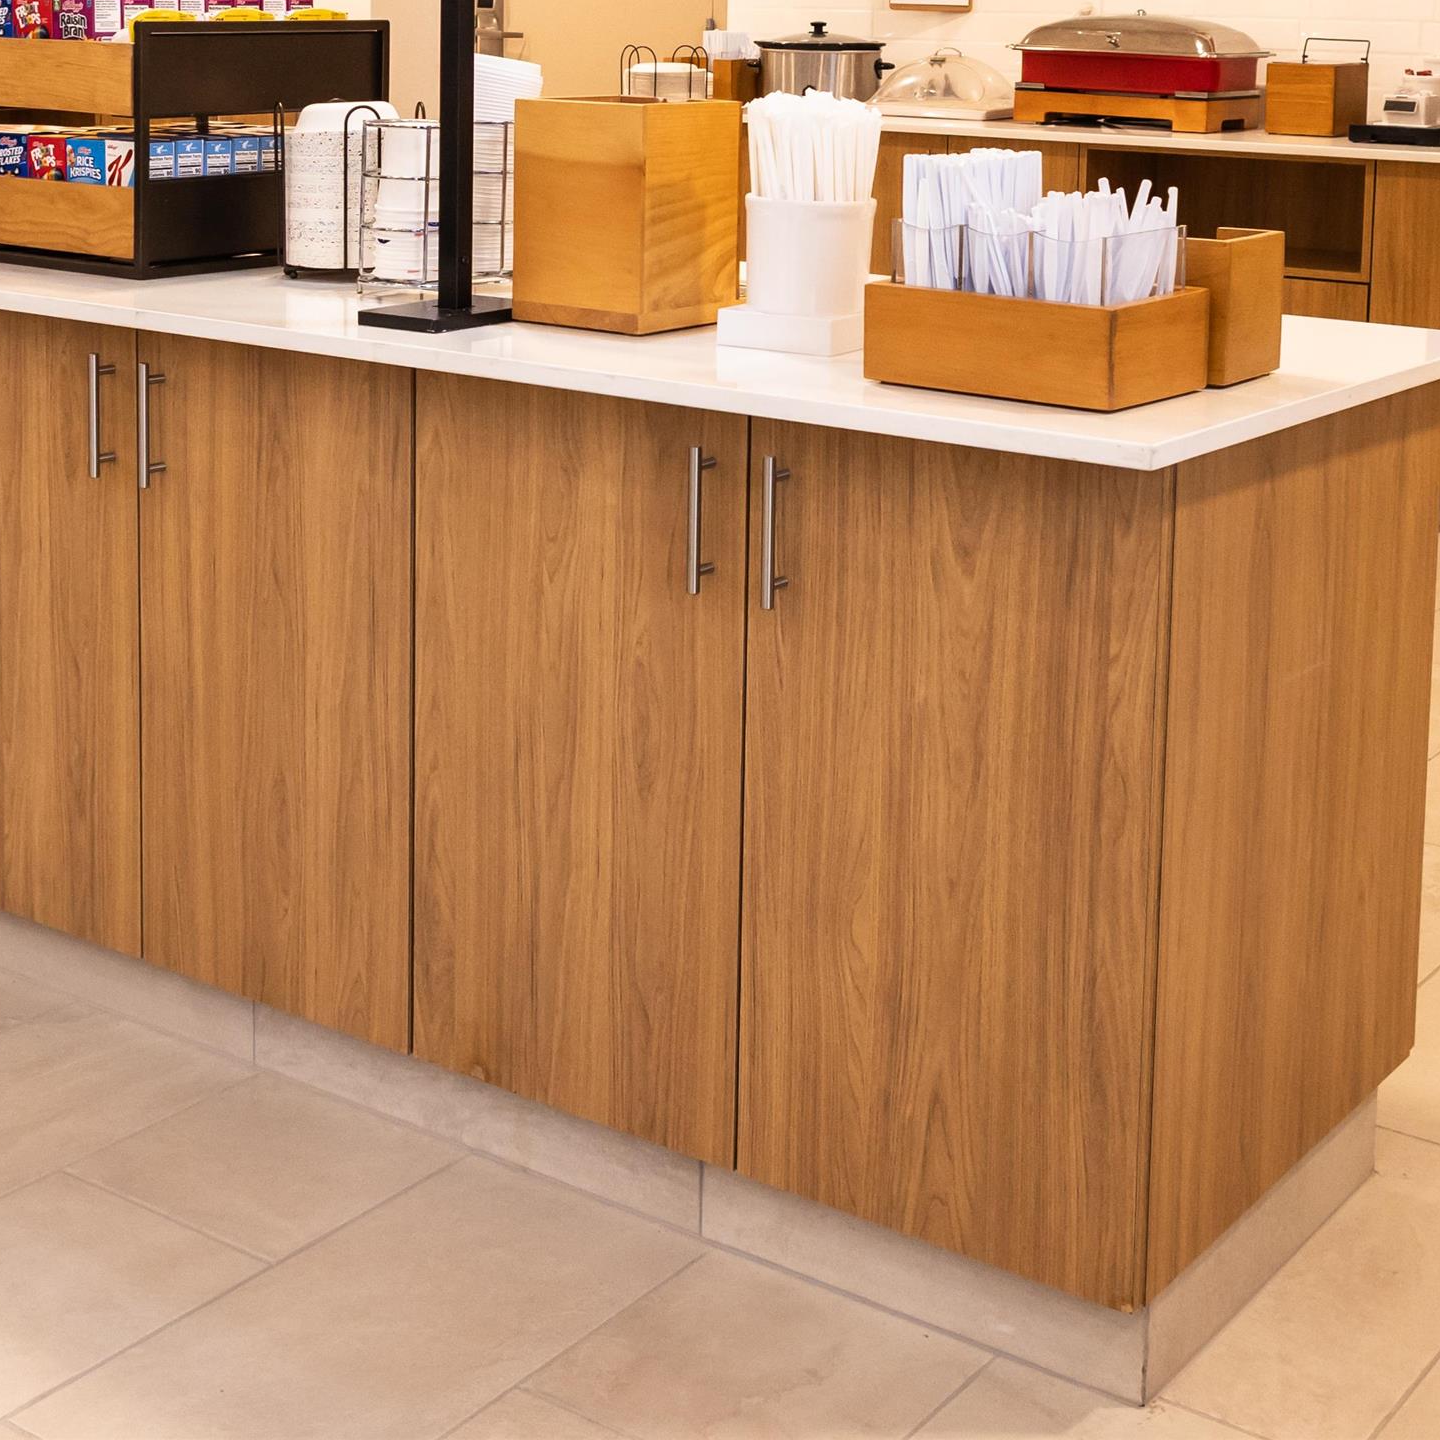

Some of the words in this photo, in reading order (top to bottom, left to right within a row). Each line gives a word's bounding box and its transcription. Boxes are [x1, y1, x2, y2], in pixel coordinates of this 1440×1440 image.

[60, 12, 88, 30] Raisin
[63, 24, 86, 39] Bran
[76, 155, 95, 168] RICE
[69, 165, 102, 180] KRISPIES
